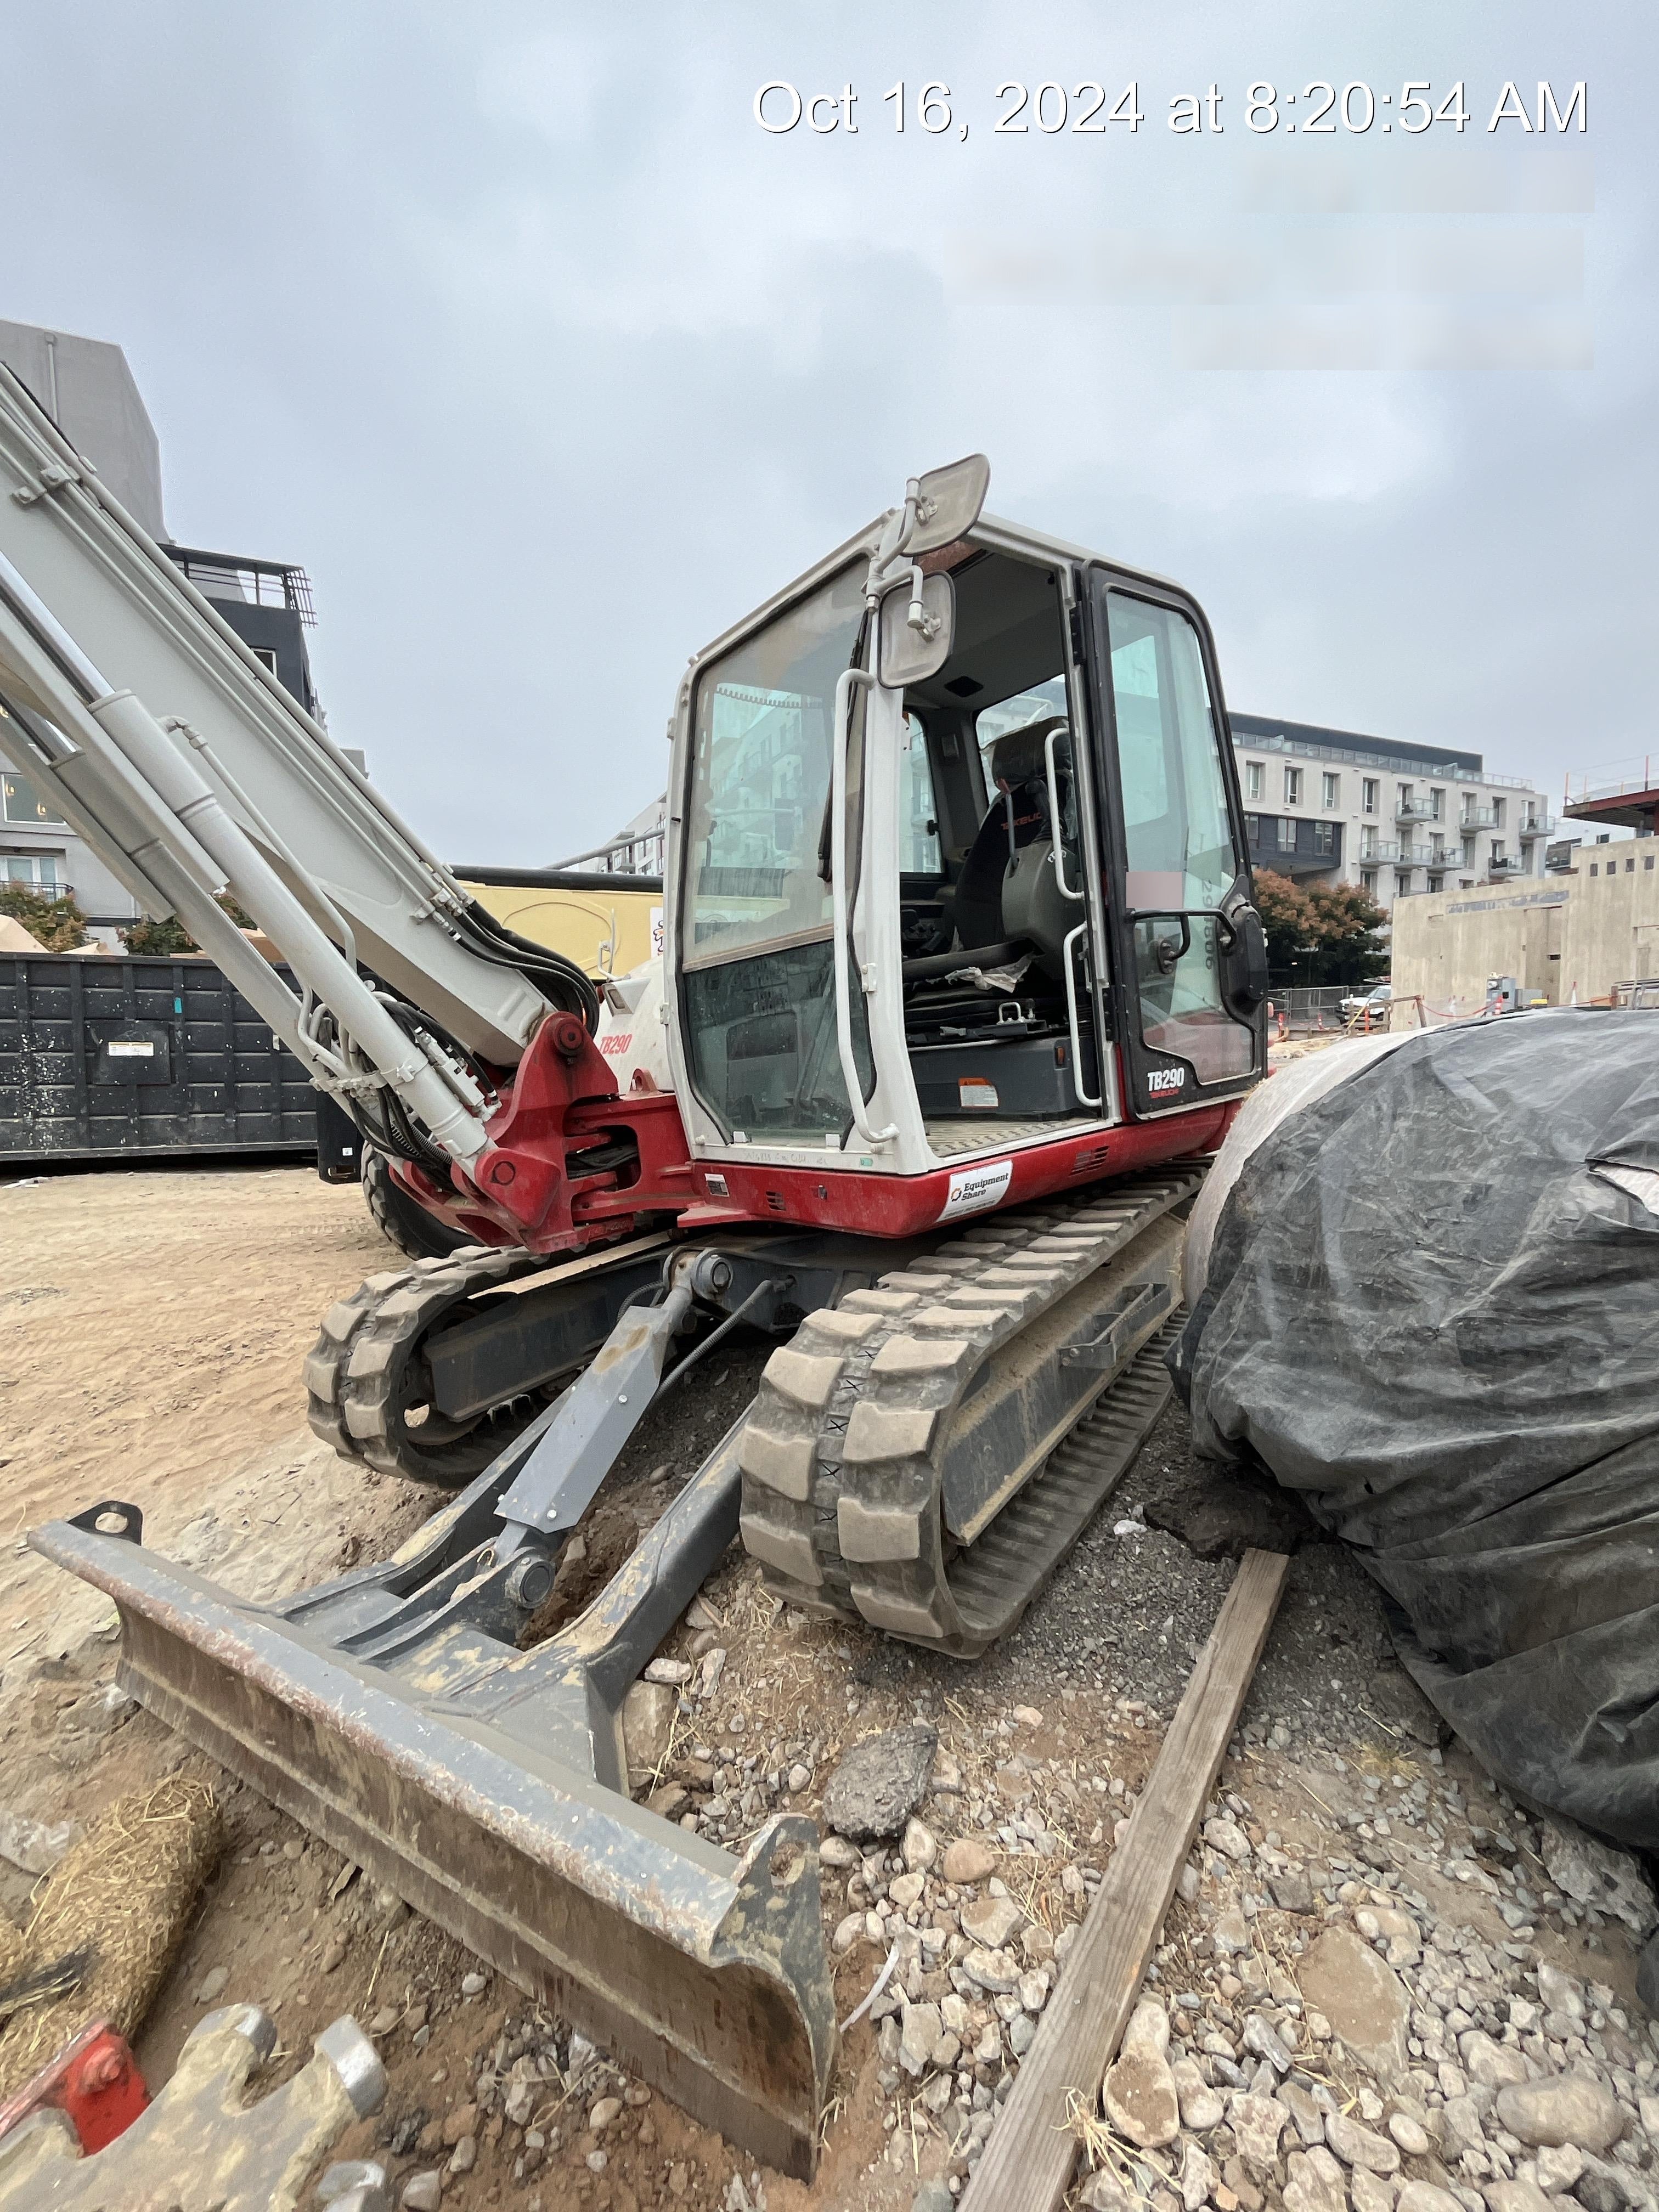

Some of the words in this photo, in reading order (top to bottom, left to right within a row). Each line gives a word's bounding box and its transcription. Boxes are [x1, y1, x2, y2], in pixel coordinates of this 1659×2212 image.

[600, 1034, 632, 1054] TB290
[1147, 1067, 1185, 1092] TB290
[964, 1172, 1009, 1192] Equipment
